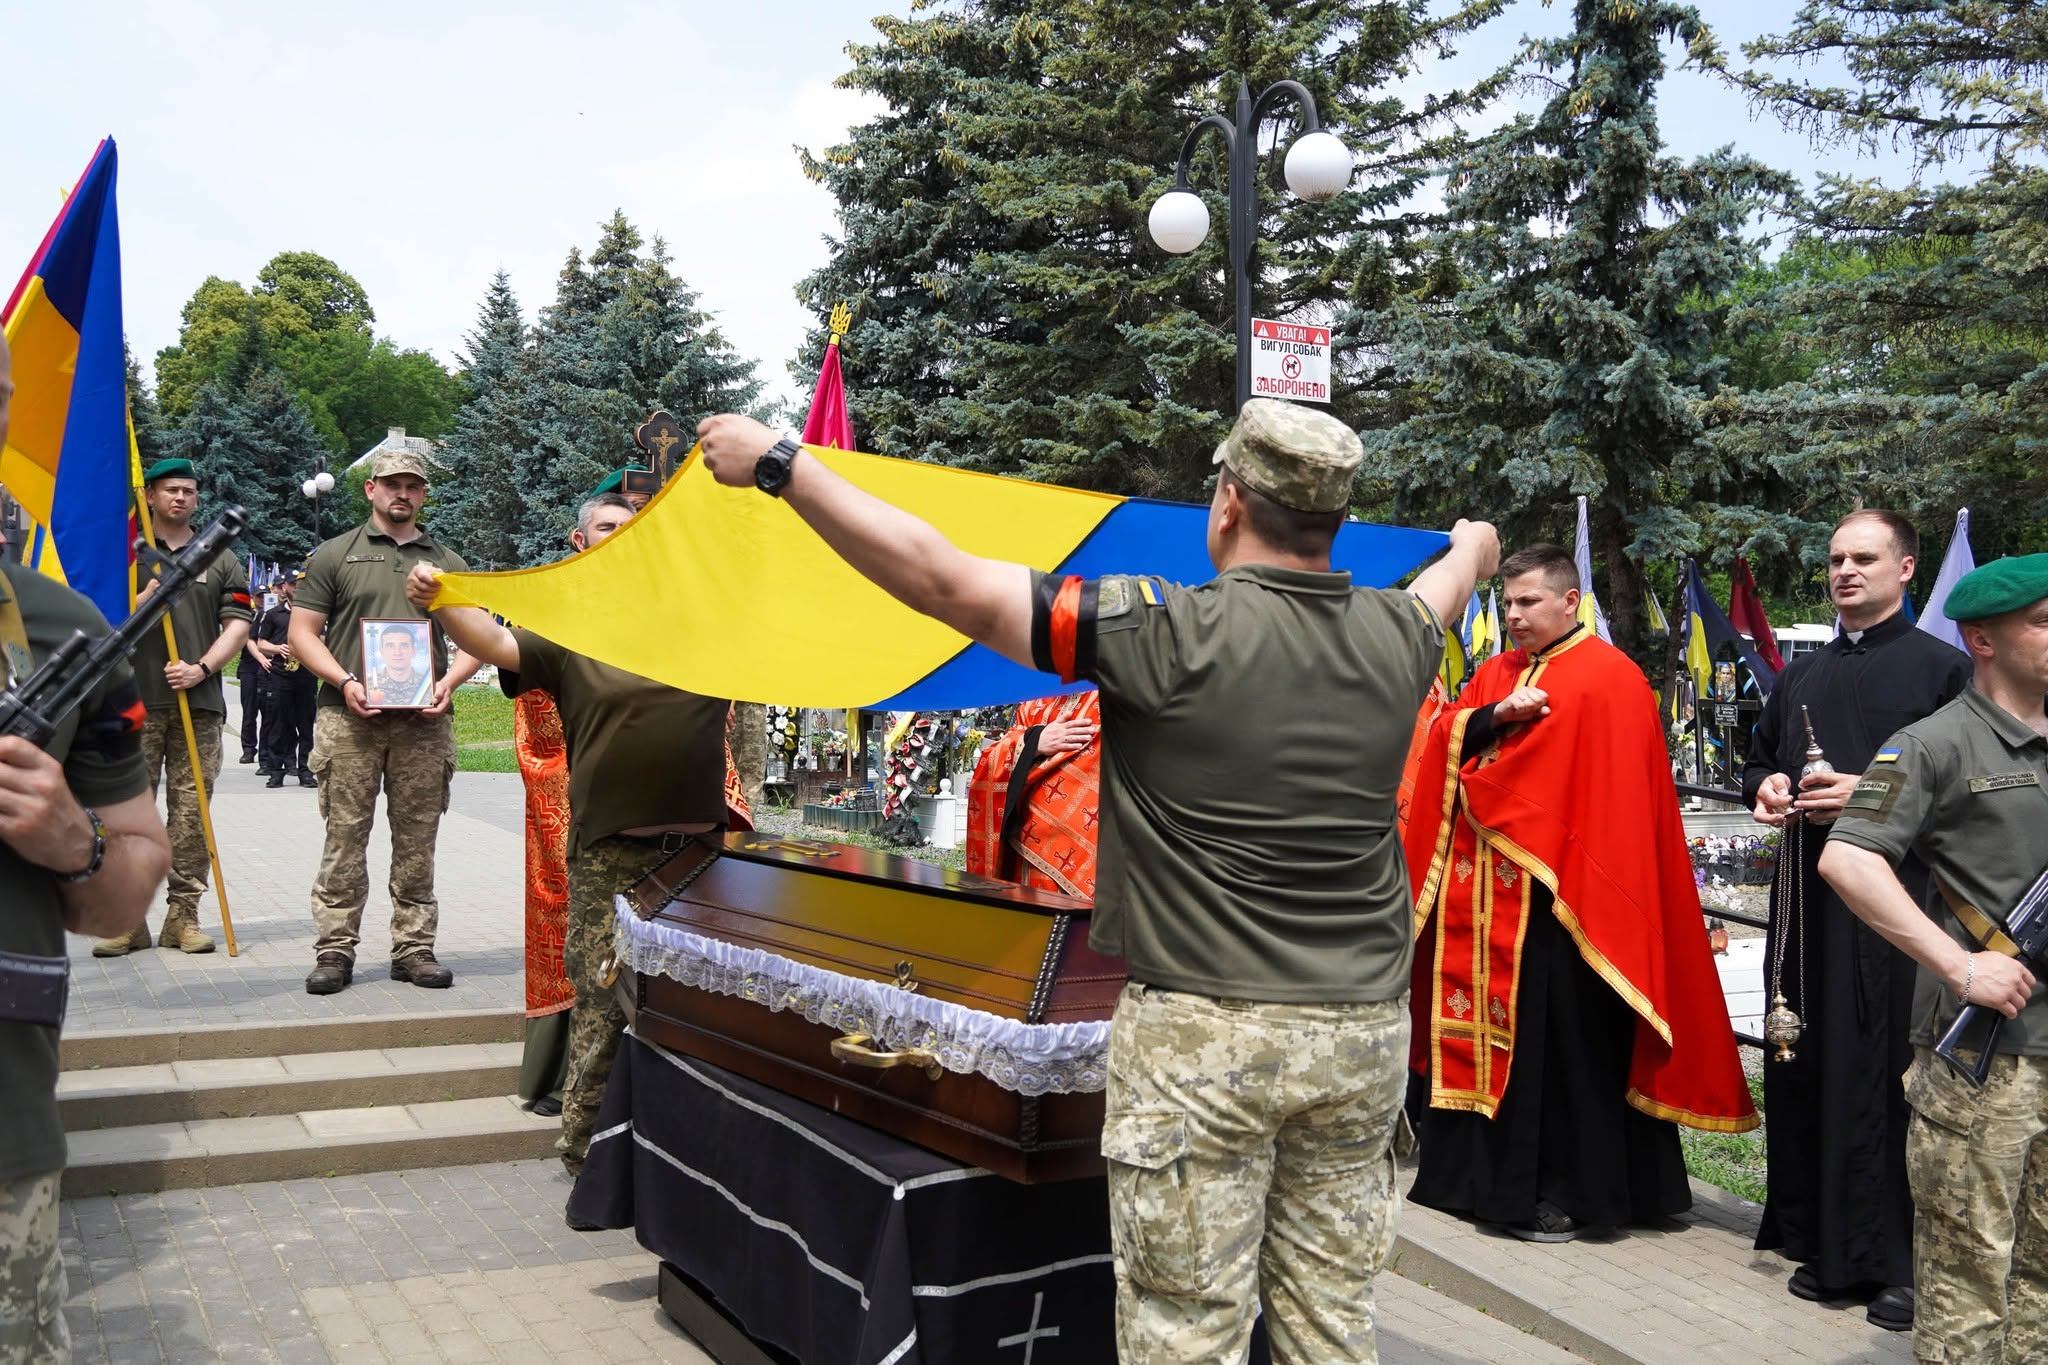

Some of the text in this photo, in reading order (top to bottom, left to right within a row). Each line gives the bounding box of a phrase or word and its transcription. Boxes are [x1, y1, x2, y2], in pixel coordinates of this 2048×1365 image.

[1276, 326, 1307, 341] УВАГА!
[1260, 339, 1322, 357] ВИГУЛ СОБАК
[1256, 376, 1326, 398] ЗАБОРОНЕНО
[1857, 782, 1887, 790] УКРАЇНА
